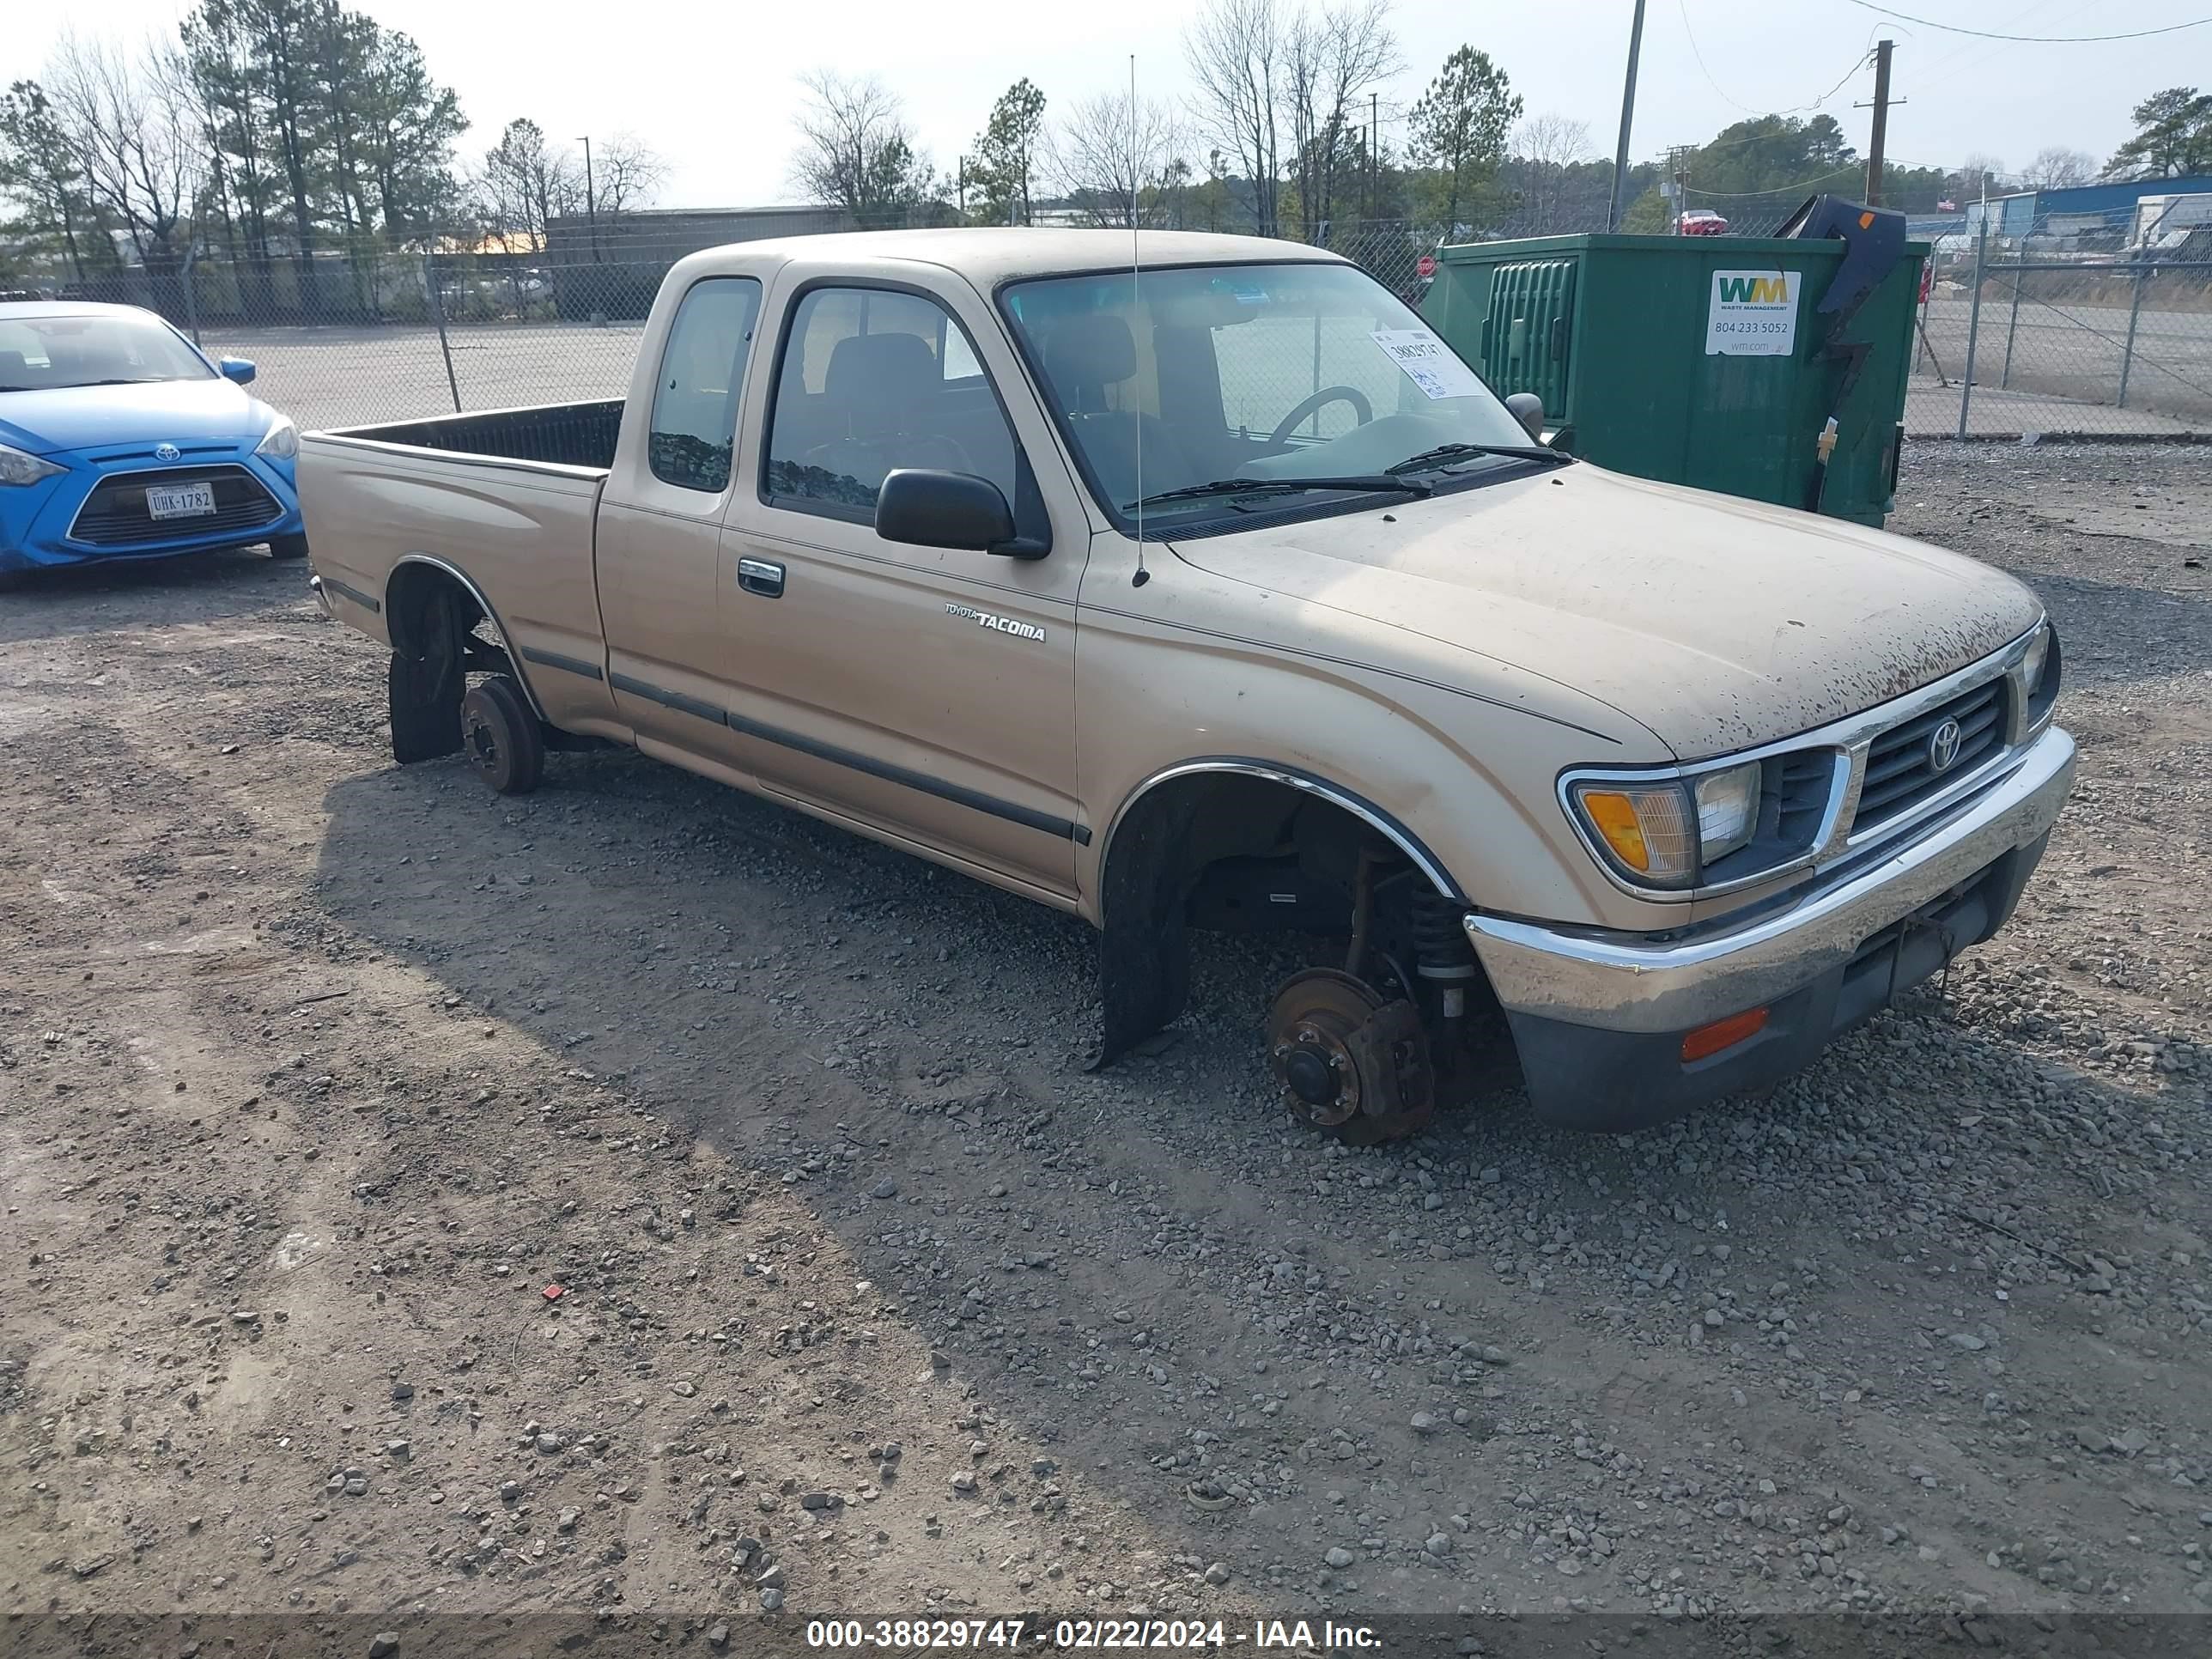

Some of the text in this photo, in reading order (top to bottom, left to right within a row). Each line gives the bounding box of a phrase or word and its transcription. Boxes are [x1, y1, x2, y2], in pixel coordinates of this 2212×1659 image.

[1719, 277, 1788, 303] WM
[1716, 322, 1788, 333] 804 233 5052
[1390, 344, 1443, 359] 38829747
[1731, 343, 1769, 351] wm.com
[152, 493, 210, 511] UHK-1782
[945, 603, 1045, 642] TOYOTA TACOMA
